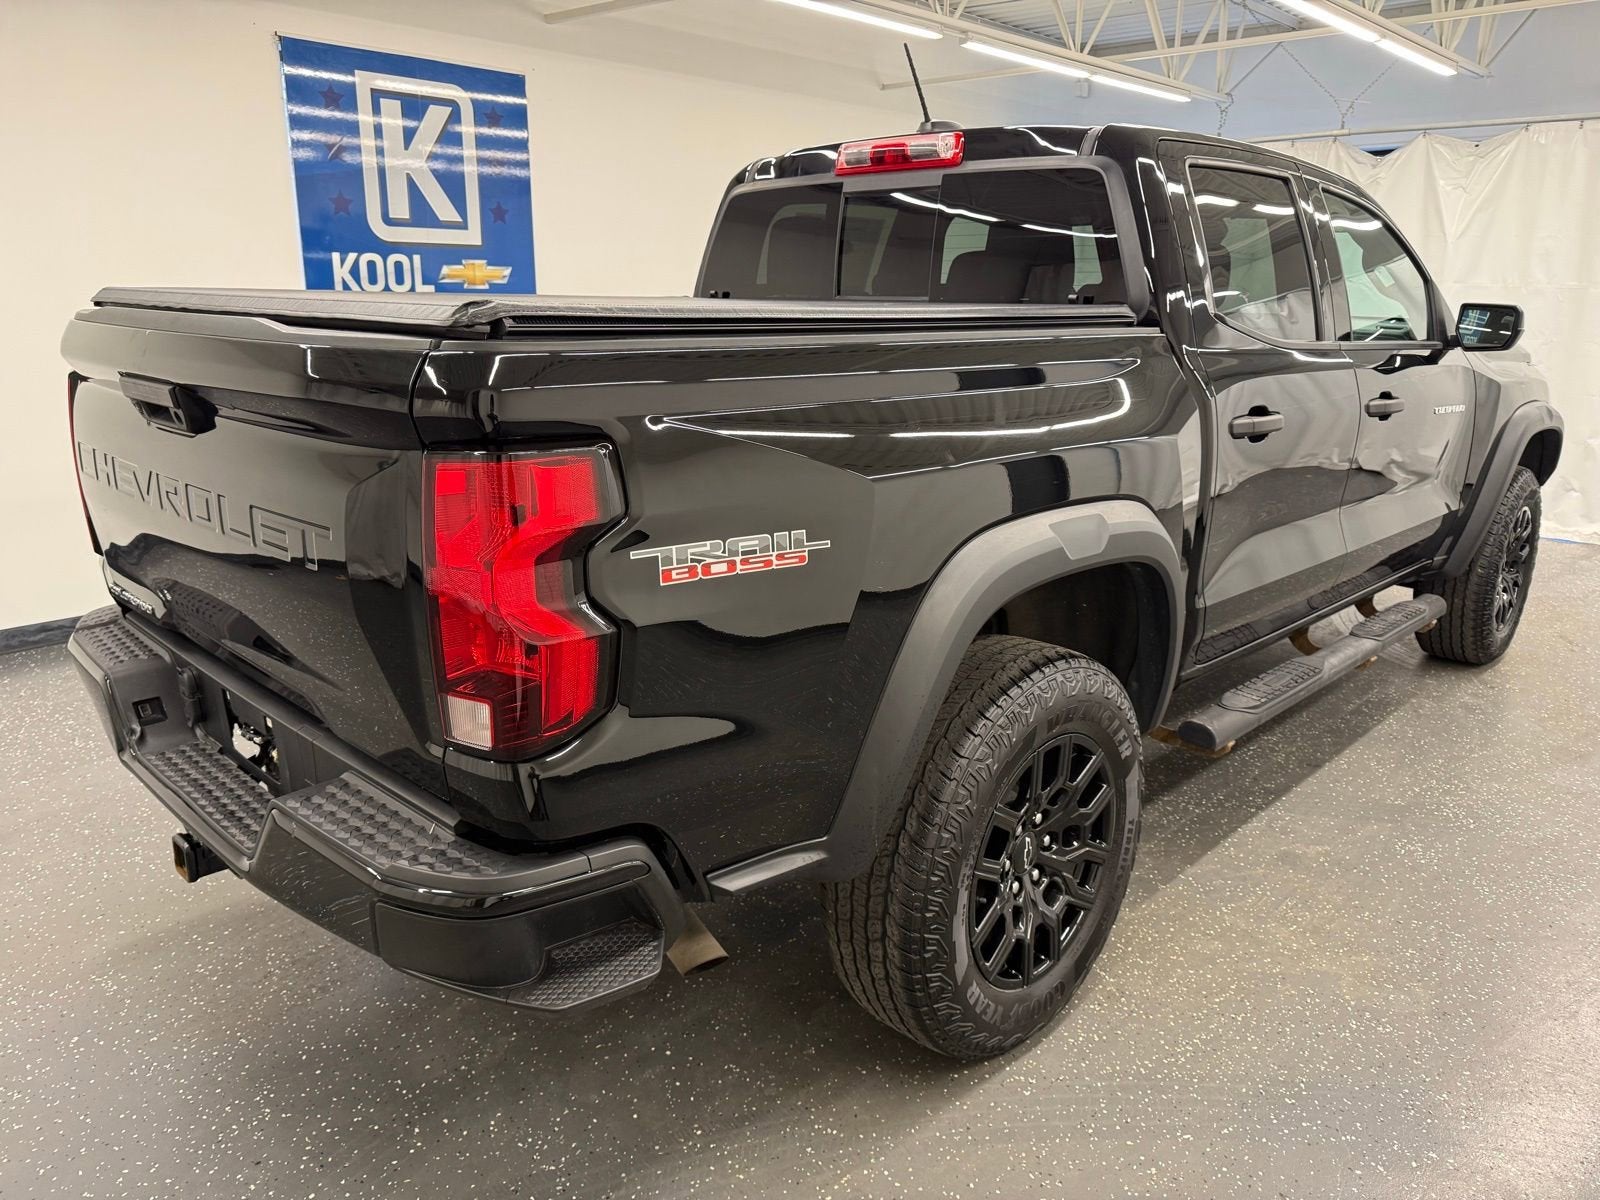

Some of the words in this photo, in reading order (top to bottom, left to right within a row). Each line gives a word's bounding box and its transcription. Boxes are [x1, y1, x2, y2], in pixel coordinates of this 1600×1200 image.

[379, 98, 463, 222] K
[331, 252, 435, 292] KOOL
[78, 441, 333, 571] CHEVROLET
[629, 529, 831, 568] TRAIL
[660, 549, 808, 587] BOSS
